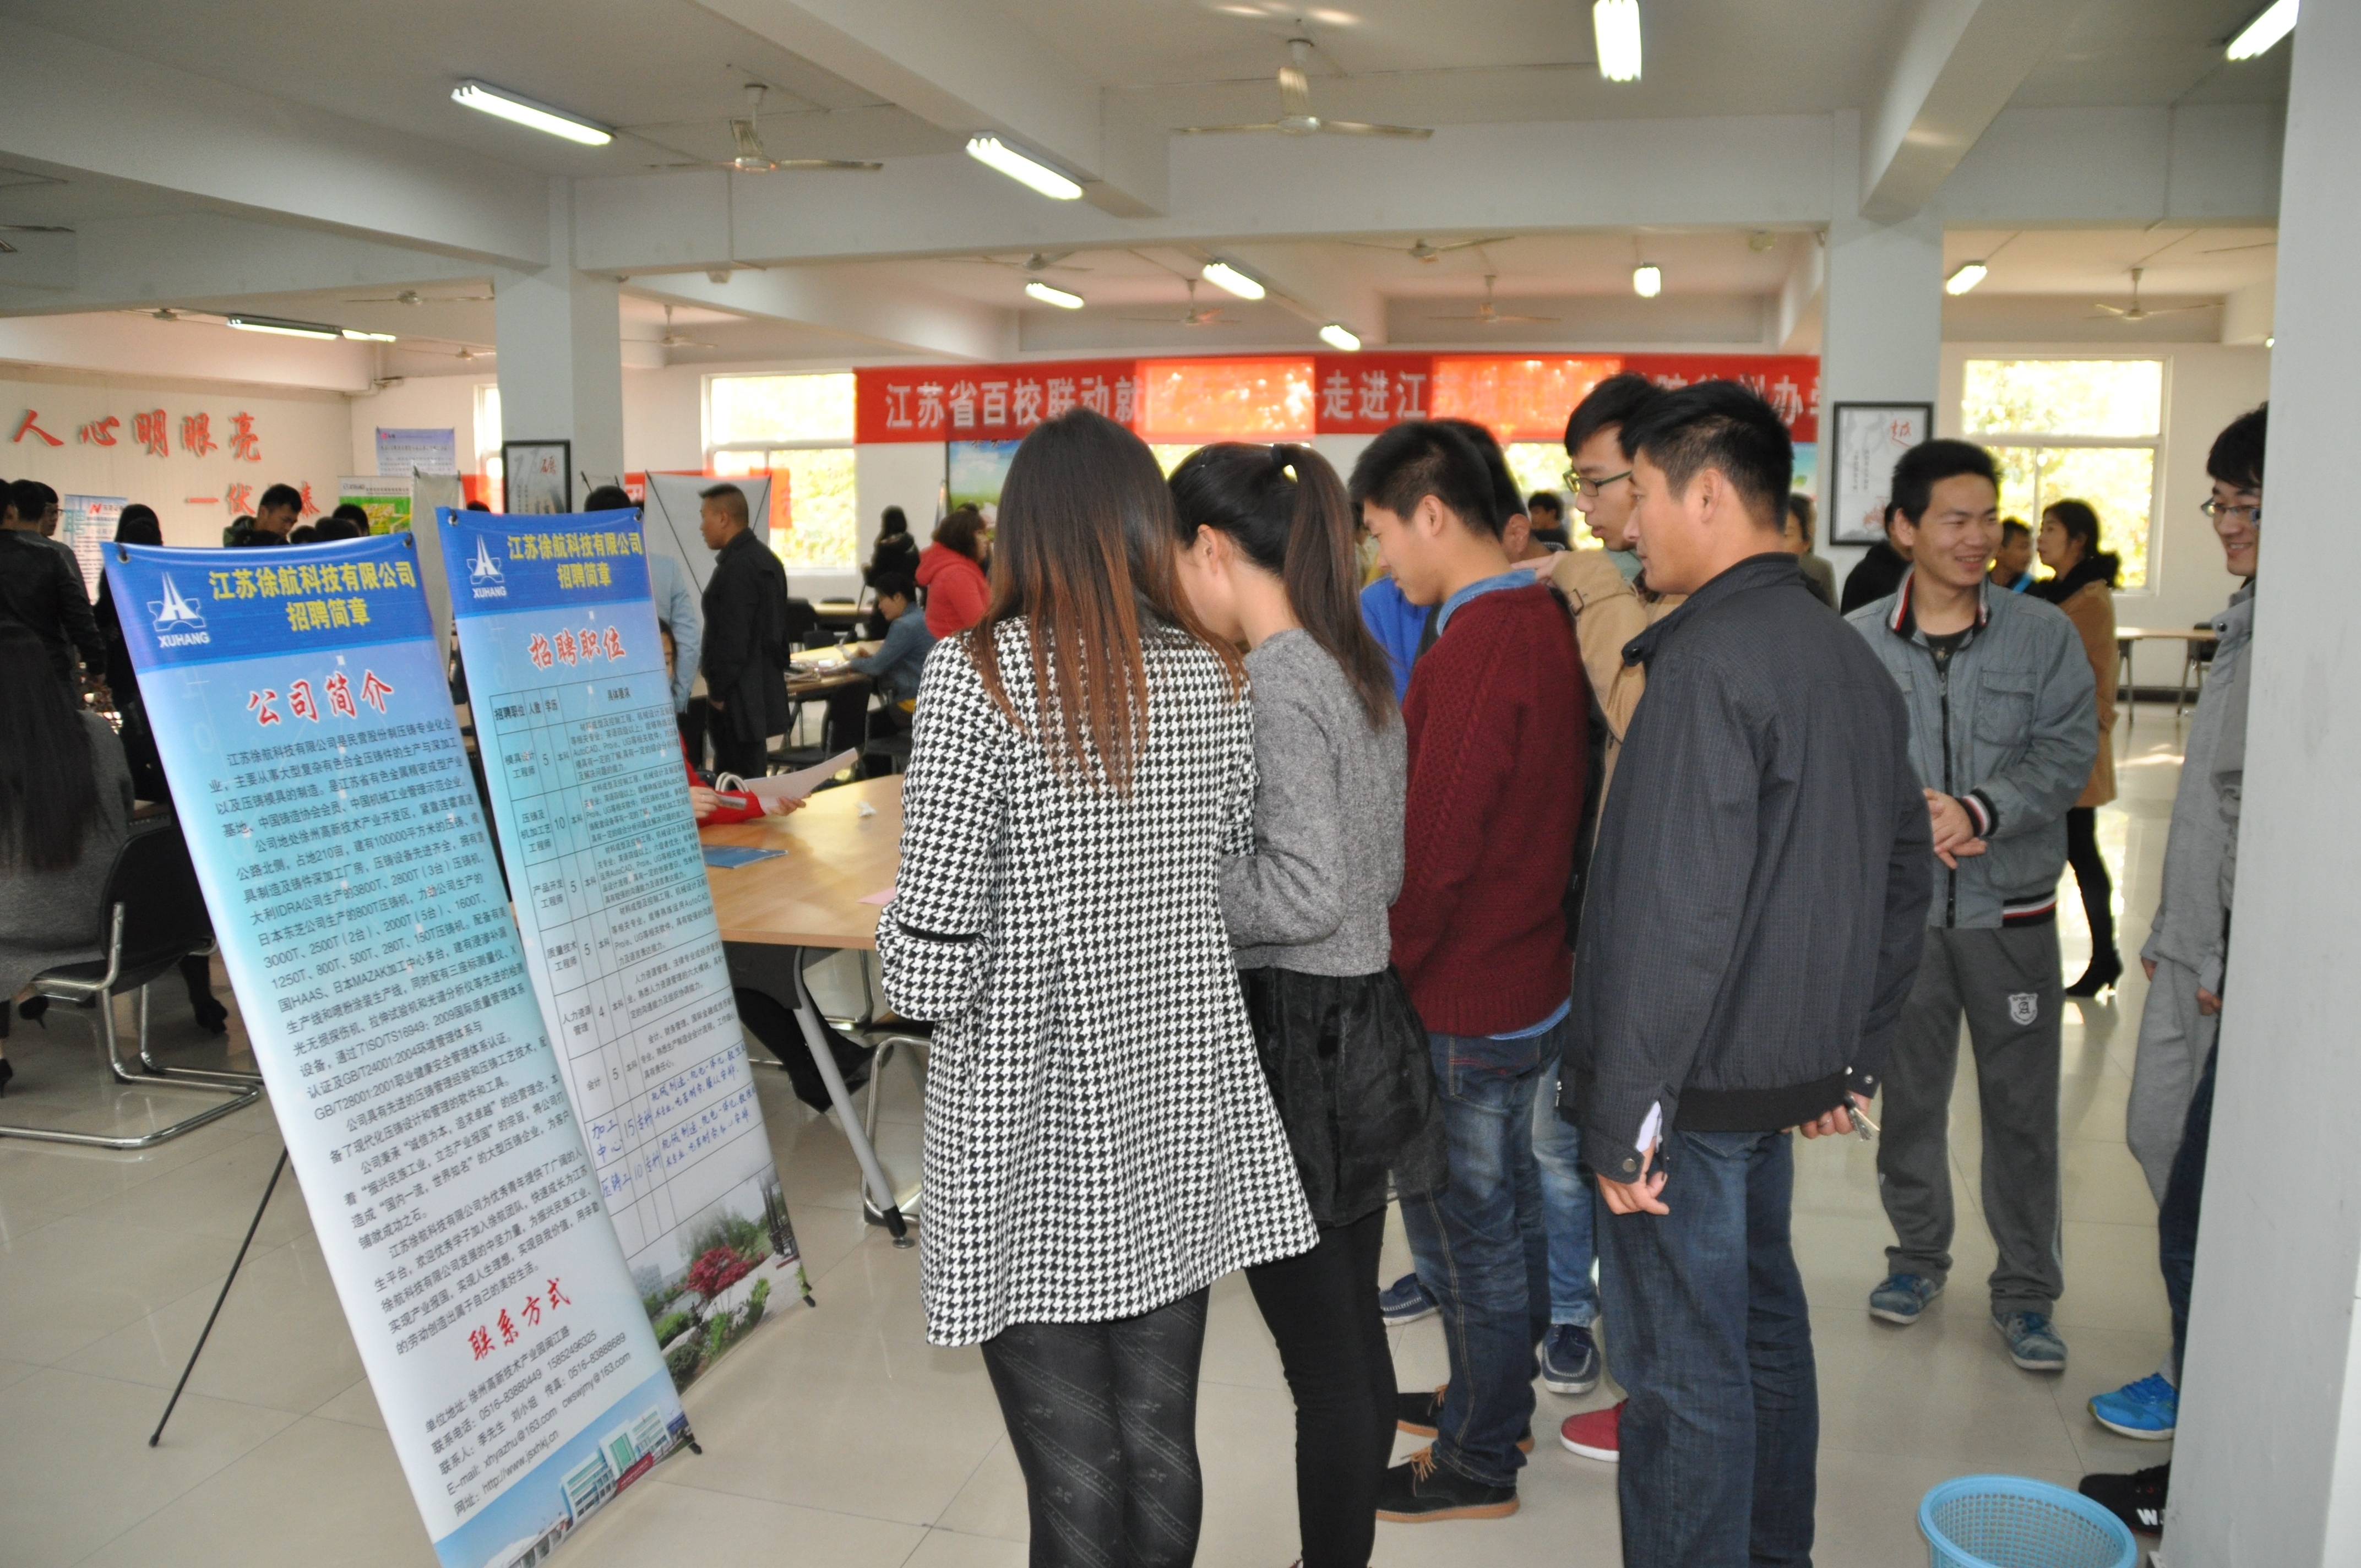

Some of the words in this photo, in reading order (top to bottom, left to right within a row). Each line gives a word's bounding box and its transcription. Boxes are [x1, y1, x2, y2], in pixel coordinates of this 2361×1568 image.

[504, 531, 644, 560] 江苏徐航科技有限公司
[205, 560, 418, 600] 江苏徐航科技有限公司
[554, 561, 613, 589] 招聘简章
[472, 586, 507, 600] XUHANG
[282, 597, 373, 631] 招聘简章
[157, 632, 210, 648] XUHANG
[525, 625, 626, 671] 招聘职位
[247, 669, 392, 726] 公司简介
[606, 687, 630, 701] 具体要求
[493, 704, 525, 721] 招聘职位
[527, 701, 541, 715] 人数
[543, 699, 558, 712] 学历
[542, 754, 549, 766] 5
[557, 752, 569, 762] 本科
[512, 765, 536, 780] 工程师
[521, 808, 545, 825] 压铸及
[554, 816, 565, 831] 10
[570, 814, 583, 824] 本科
[520, 822, 551, 841] 机加工艺
[527, 838, 551, 854] 工程师
[531, 879, 563, 897] 产品开发
[569, 880, 576, 893] 5
[584, 878, 597, 888] 本科
[540, 892, 564, 910] 工程师
[546, 939, 577, 960] 质量技术
[584, 943, 590, 956] 5
[597, 937, 610, 950] 本科
[554, 954, 577, 972] 工程师
[597, 1006, 605, 1018] 4
[611, 999, 624, 1012] 本科
[561, 1005, 591, 1026] 人力资源
[573, 1021, 588, 1037] 管理
[612, 1068, 618, 1080] 5
[625, 1059, 638, 1073] 本科
[586, 1079, 601, 1092] 会计
[624, 1118, 635, 1136] 15
[468, 1277, 570, 1361] 联系方式
[510, 1395, 538, 1424] 刘小姐
